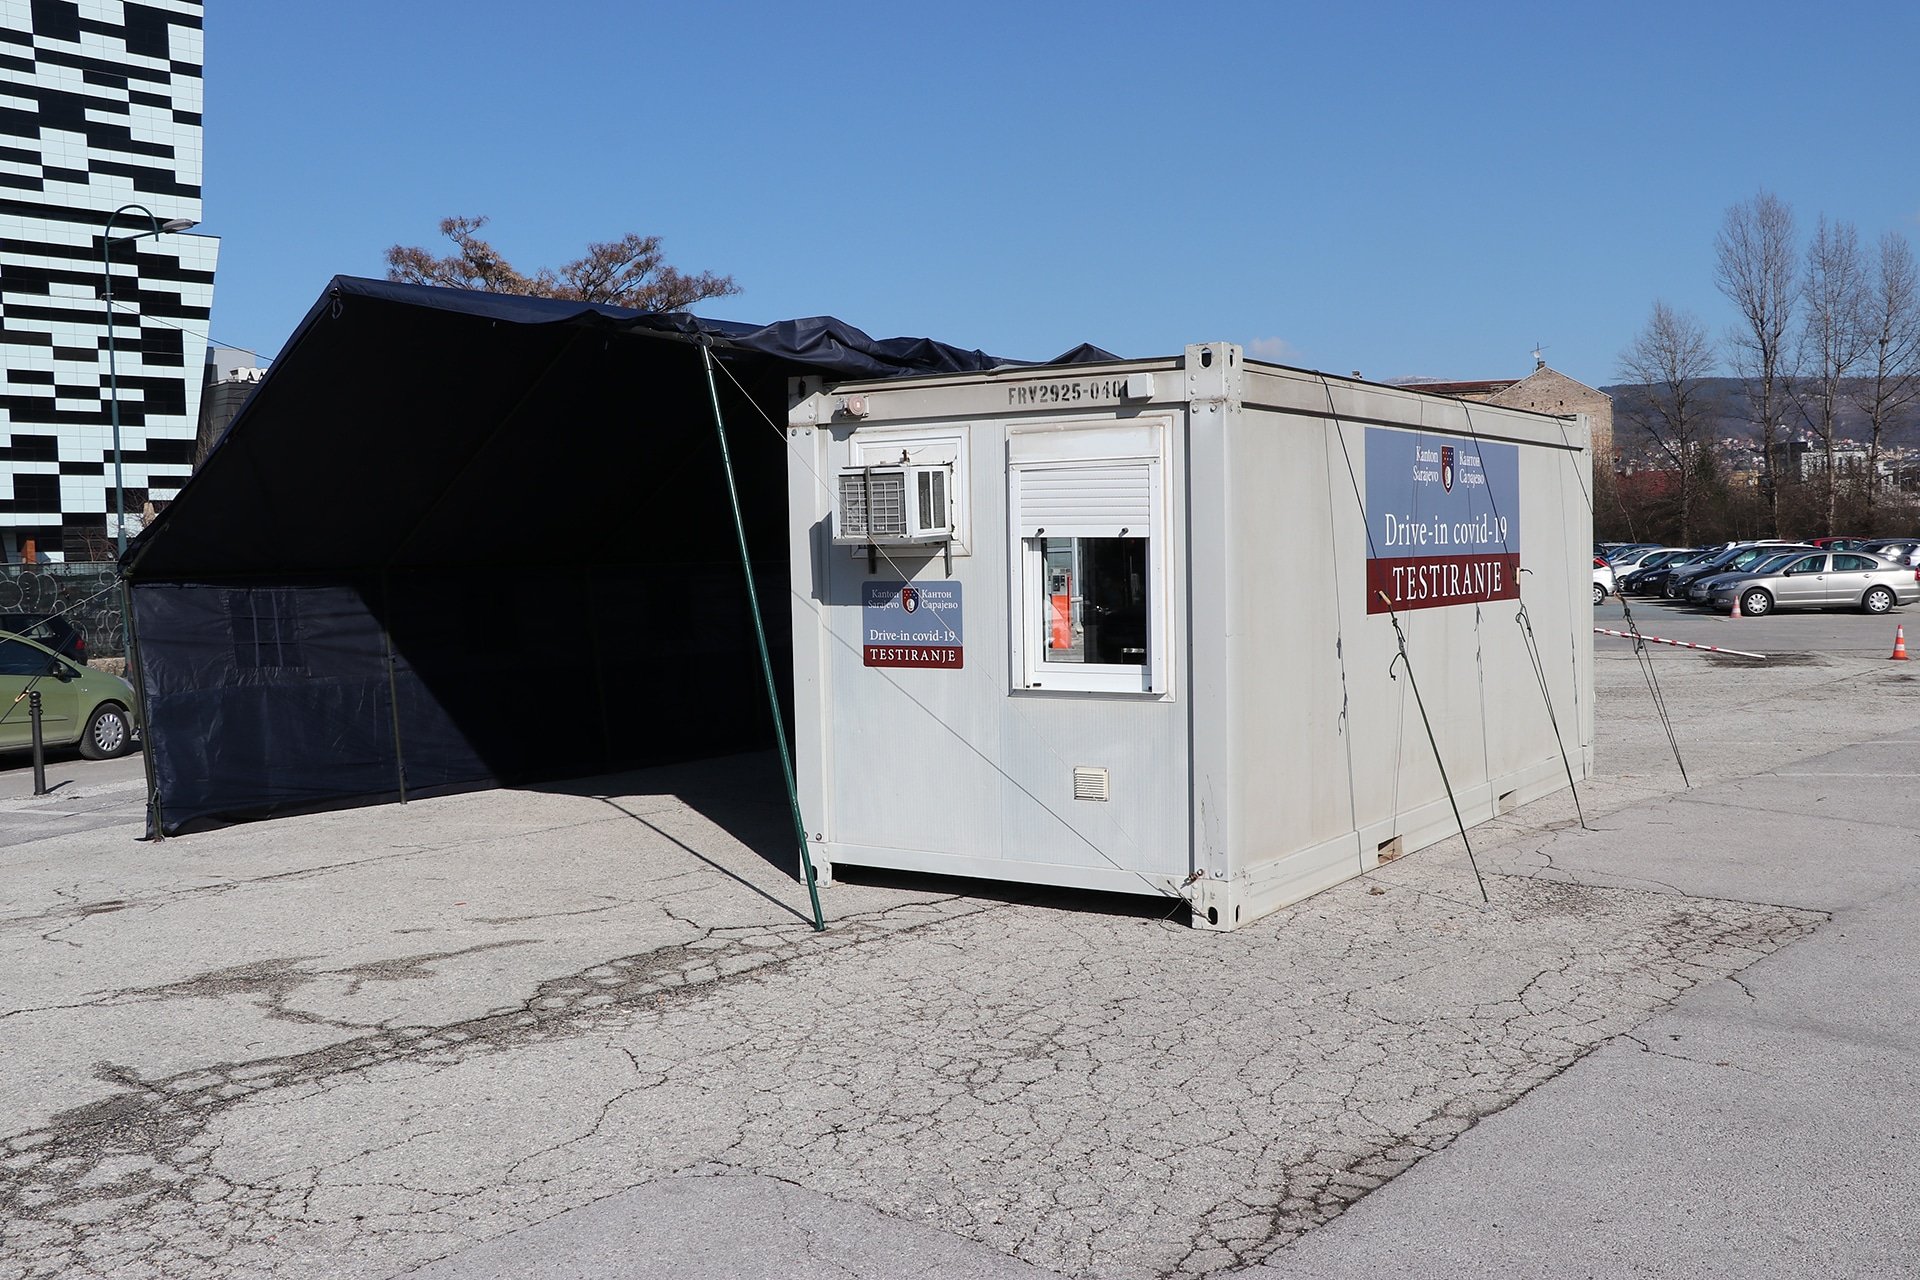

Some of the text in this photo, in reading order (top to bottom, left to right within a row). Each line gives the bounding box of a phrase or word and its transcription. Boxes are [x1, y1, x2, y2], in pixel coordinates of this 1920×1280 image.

[1416, 446, 1439, 463] Kanton
[1413, 465, 1439, 486] Sarajevo
[1385, 513, 1508, 546] Drive-in covid-19
[1393, 561, 1502, 601] TESTIRANJE
[872, 589, 899, 598] Kanton
[921, 589, 952, 598] Кантон
[868, 600, 900, 611] Sarajevo
[870, 629, 956, 642] Drive-in covid-19
[870, 649, 956, 663] TESTIRANJE
